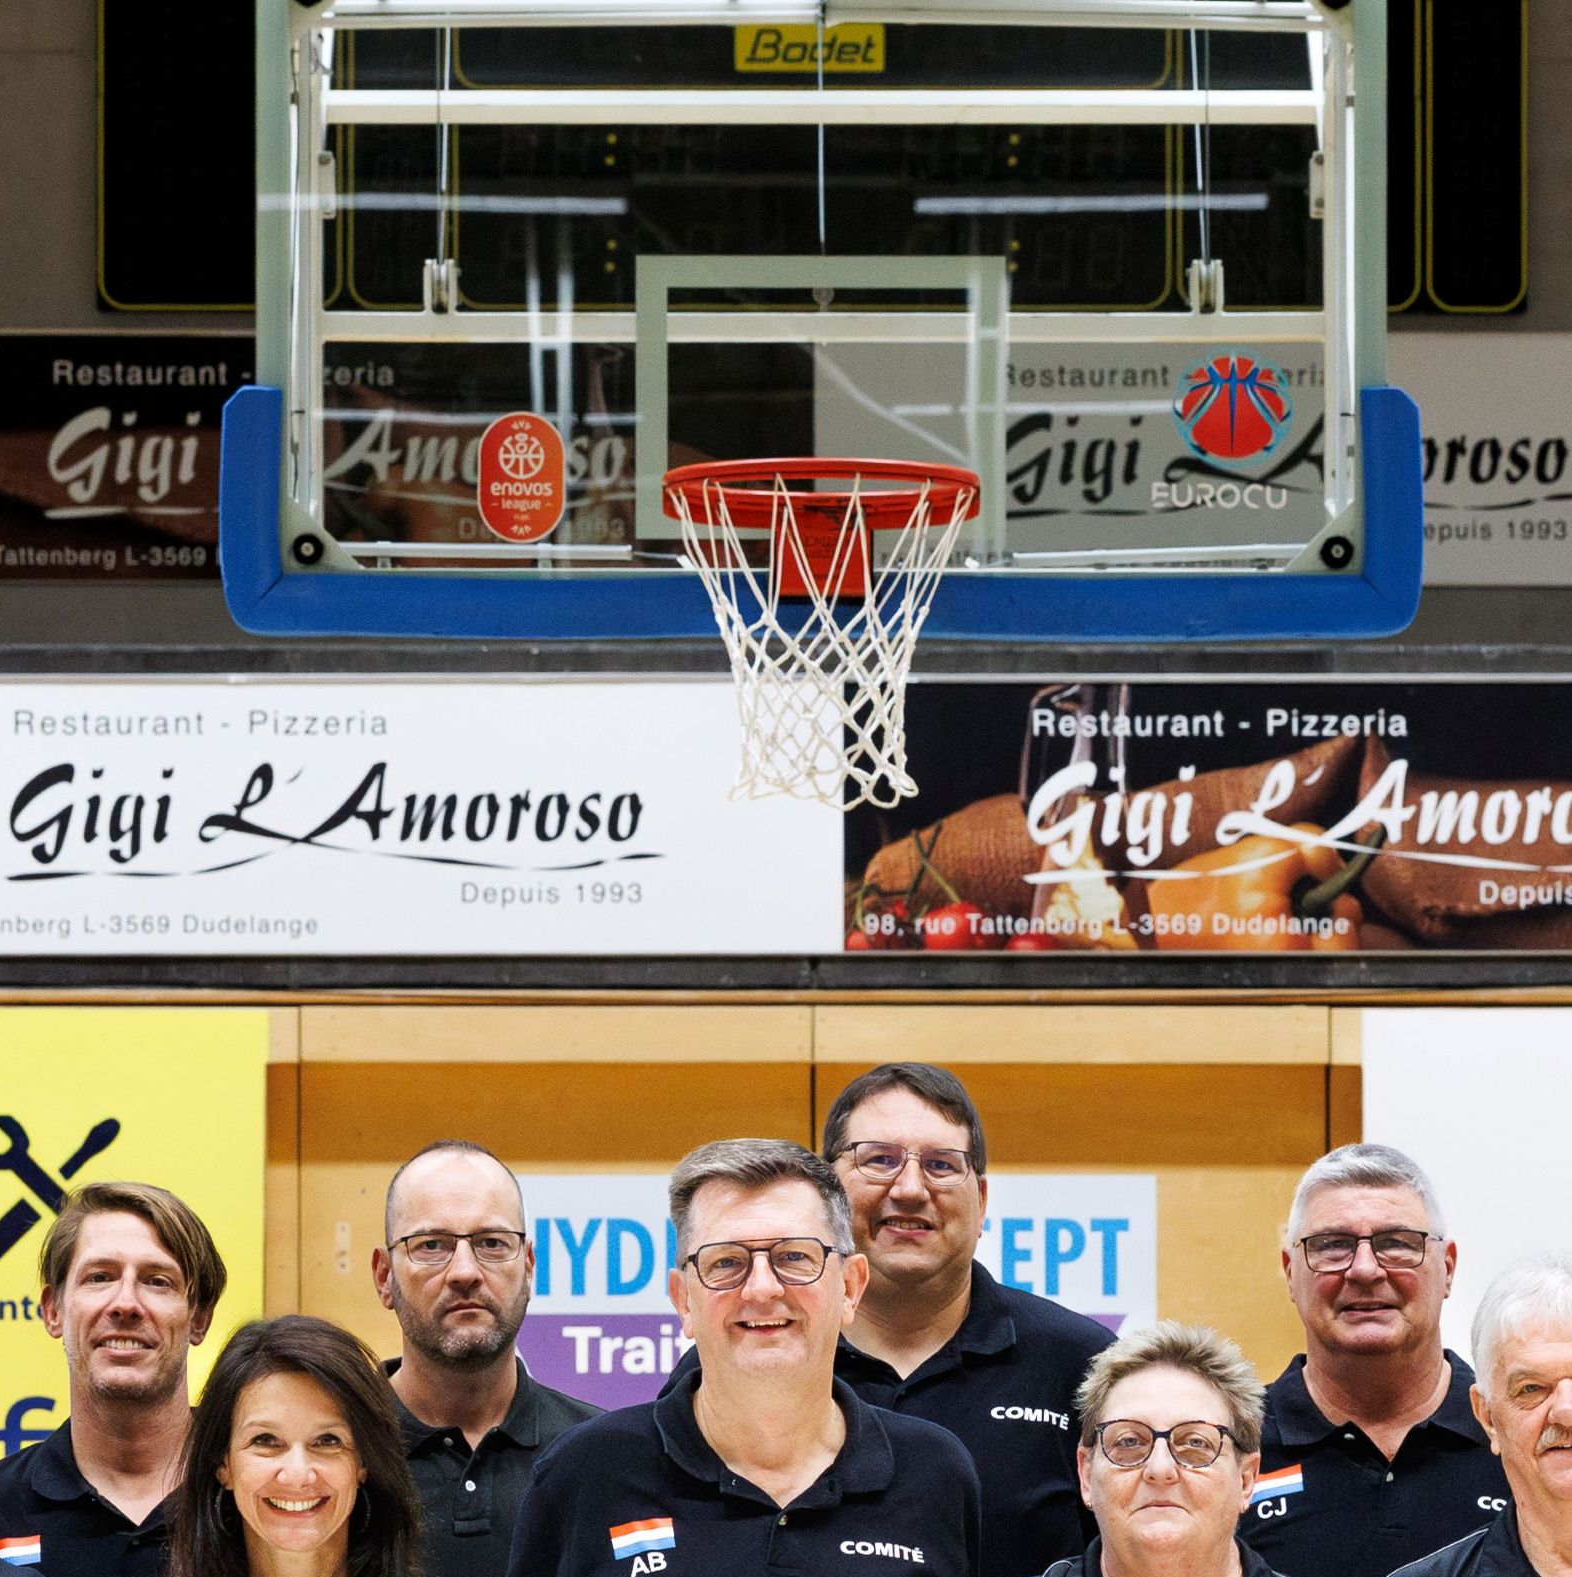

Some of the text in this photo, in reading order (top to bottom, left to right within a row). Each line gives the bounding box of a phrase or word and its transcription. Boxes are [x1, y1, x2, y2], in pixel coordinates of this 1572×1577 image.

[745, 29, 875, 64] Bodet
[52, 359, 227, 386] Restaurant
[48, 406, 202, 502] Gigi
[490, 480, 553, 497] enovos
[501, 498, 541, 513] league
[1507, 520, 1569, 541] 1993
[125, 546, 206, 566] L-3569
[14, 710, 389, 737] Restaurant Pizzeria
[1031, 709, 1409, 738] Restaurant Pizzeria
[10, 762, 176, 863] Gigi
[1028, 759, 1197, 867] Gigi
[461, 882, 644, 908] Depuis 1993
[82, 914, 172, 935] L-3569
[181, 914, 320, 938] Dudelange
[864, 914, 1350, 940] 98, rue Tattenberg L-3569 Dudelange
[990, 1405, 1069, 1430] COMITÉ
[1257, 1497, 1287, 1520] CJ
[839, 1539, 926, 1564] COMITÉ
